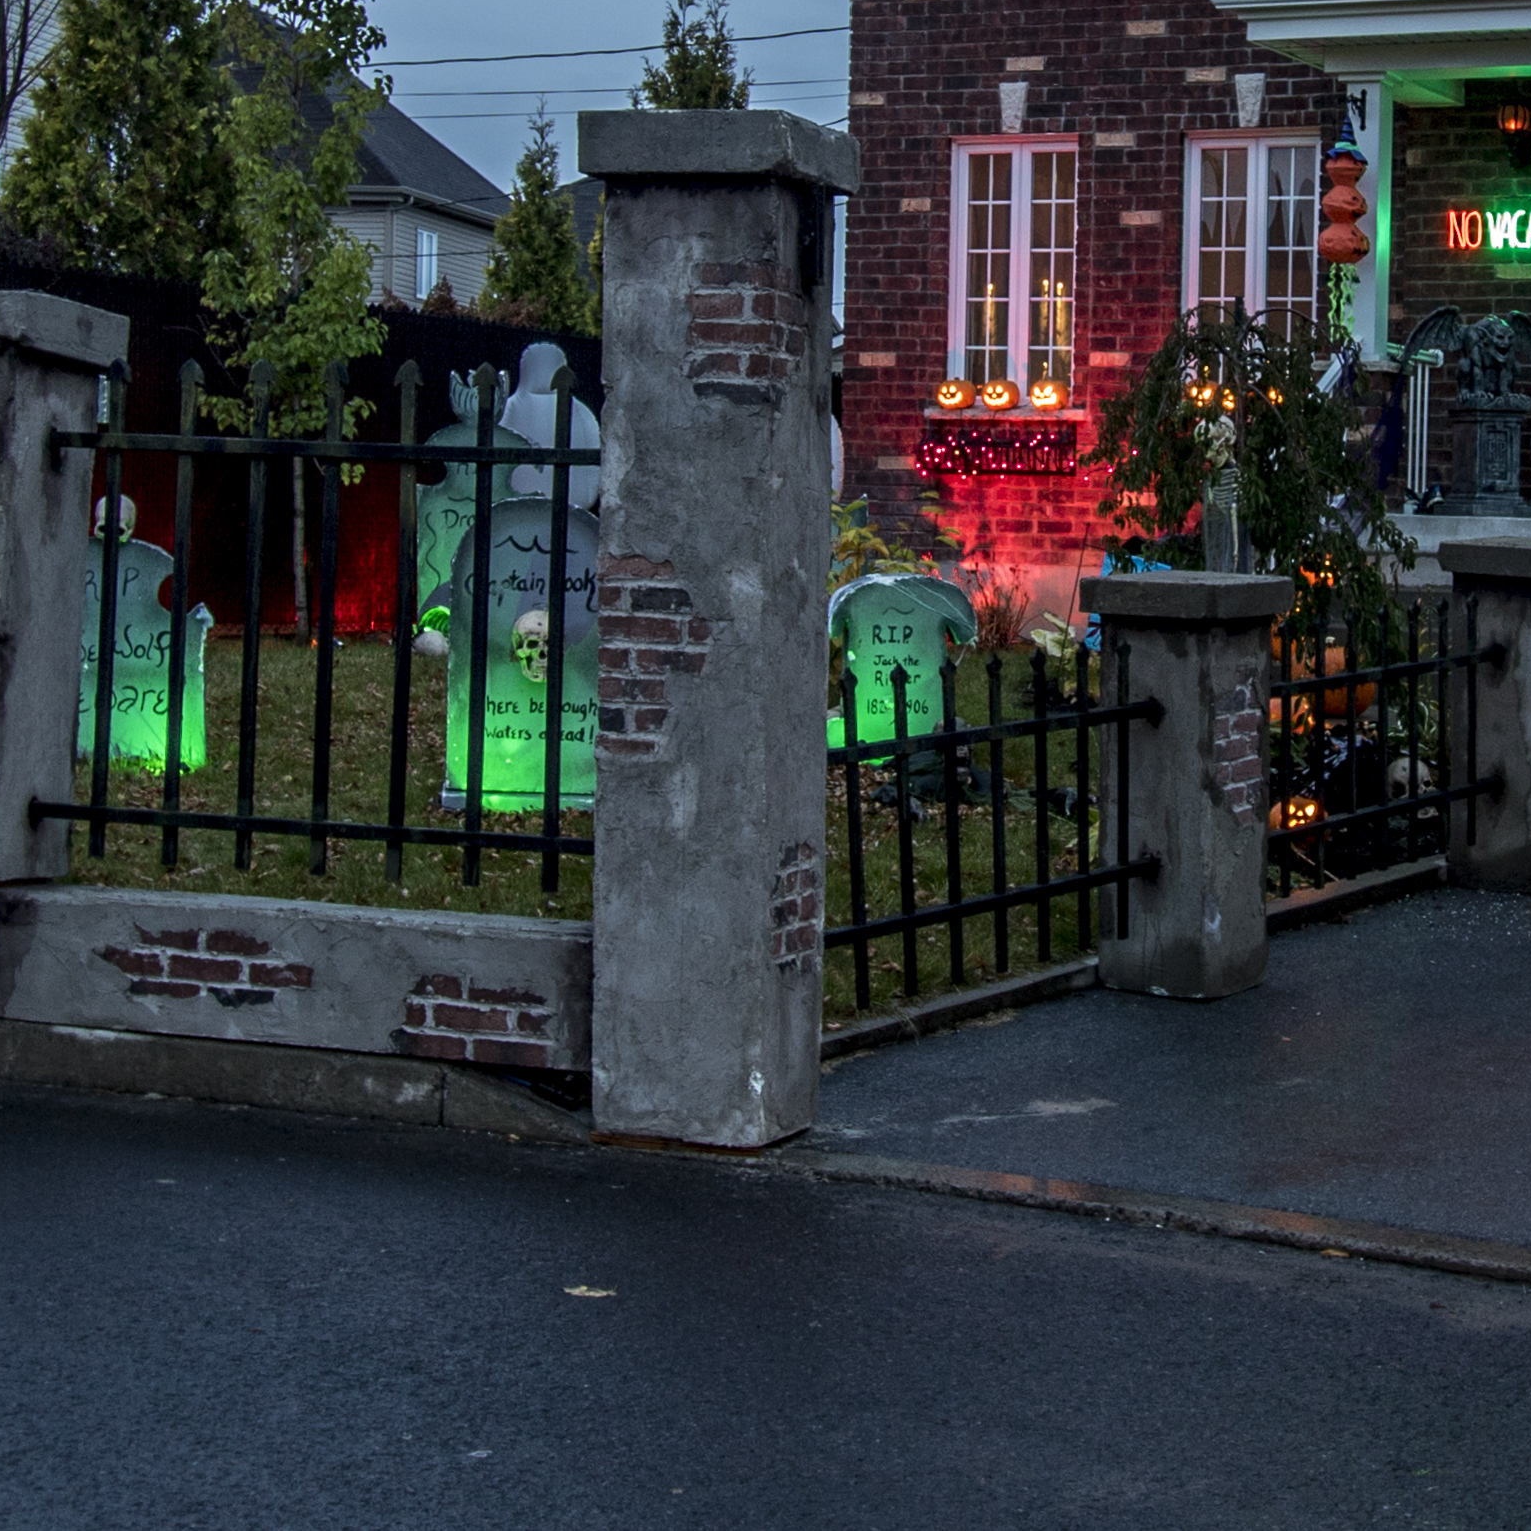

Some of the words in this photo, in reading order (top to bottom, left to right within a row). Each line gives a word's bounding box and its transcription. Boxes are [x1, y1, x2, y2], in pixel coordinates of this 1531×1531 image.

[1448, 209, 1483, 249] NO
[563, 567, 599, 613] ook
[902, 654, 920, 667] the
[874, 670, 922, 687] Rier
[528, 696, 545, 714] be
[561, 696, 599, 722] ough
